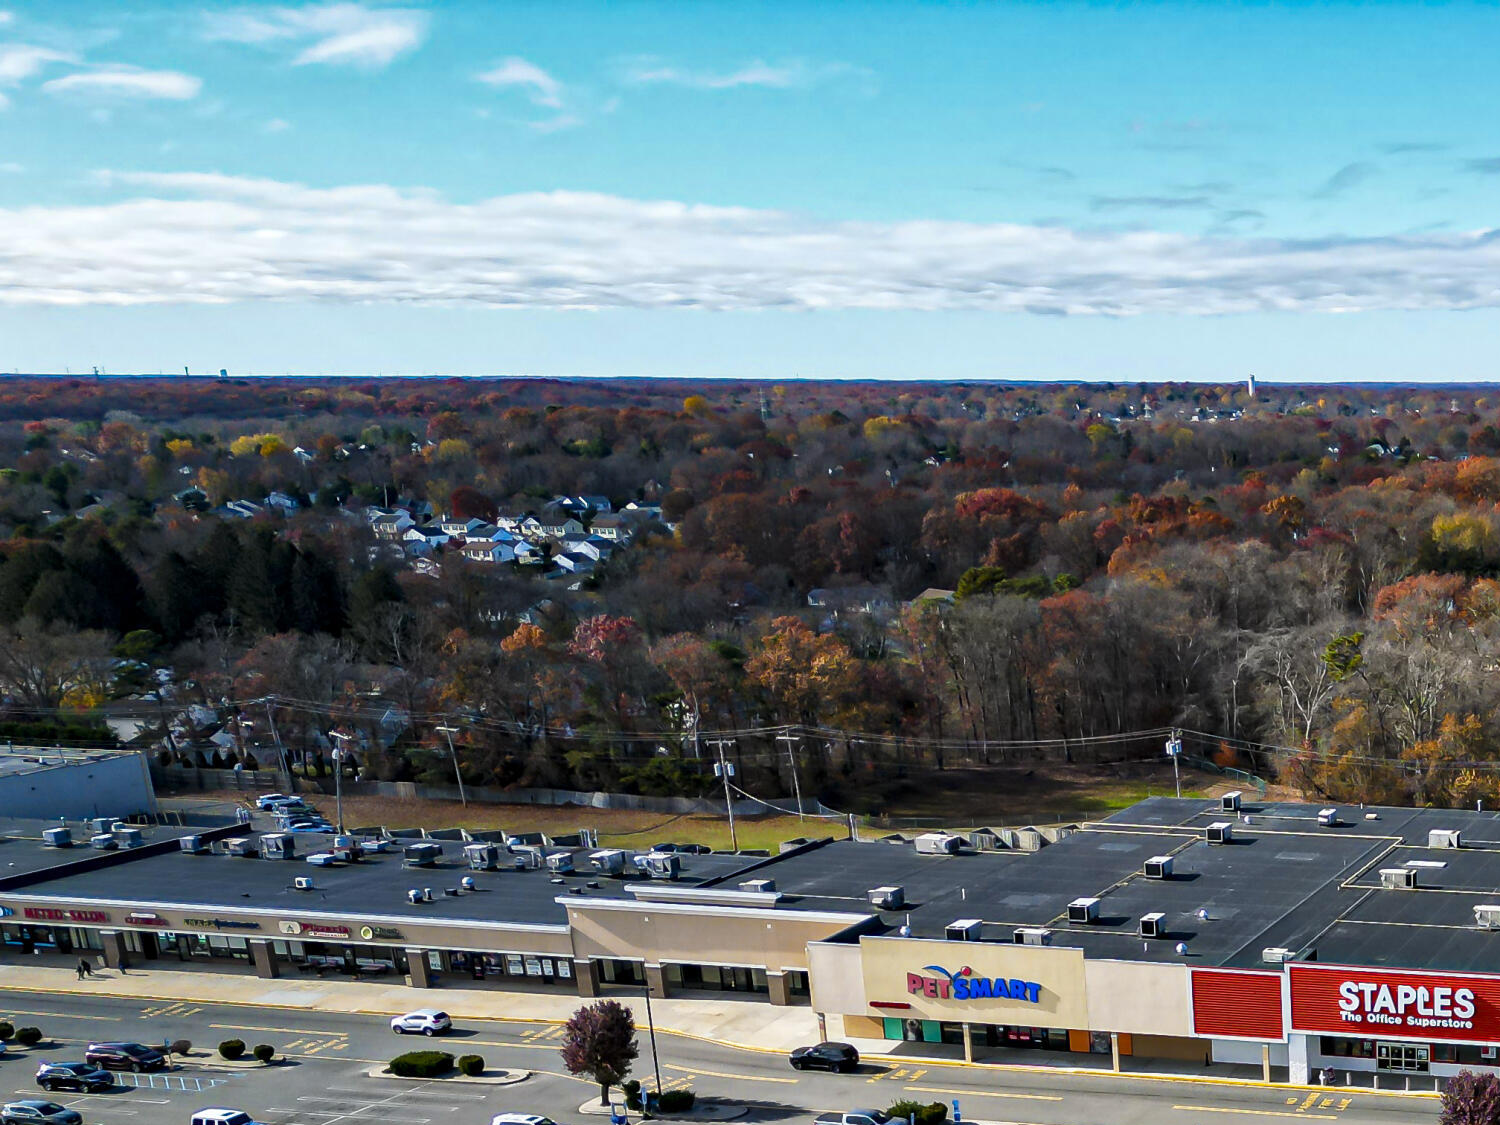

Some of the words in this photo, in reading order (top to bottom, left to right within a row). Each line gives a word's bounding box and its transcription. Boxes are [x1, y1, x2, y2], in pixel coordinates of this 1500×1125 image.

[1338, 981, 1475, 1019] STAPLES
[1340, 1011, 1362, 1022] The
[1367, 1013, 1402, 1025] Office
[1406, 1016, 1473, 1029] Superstore
